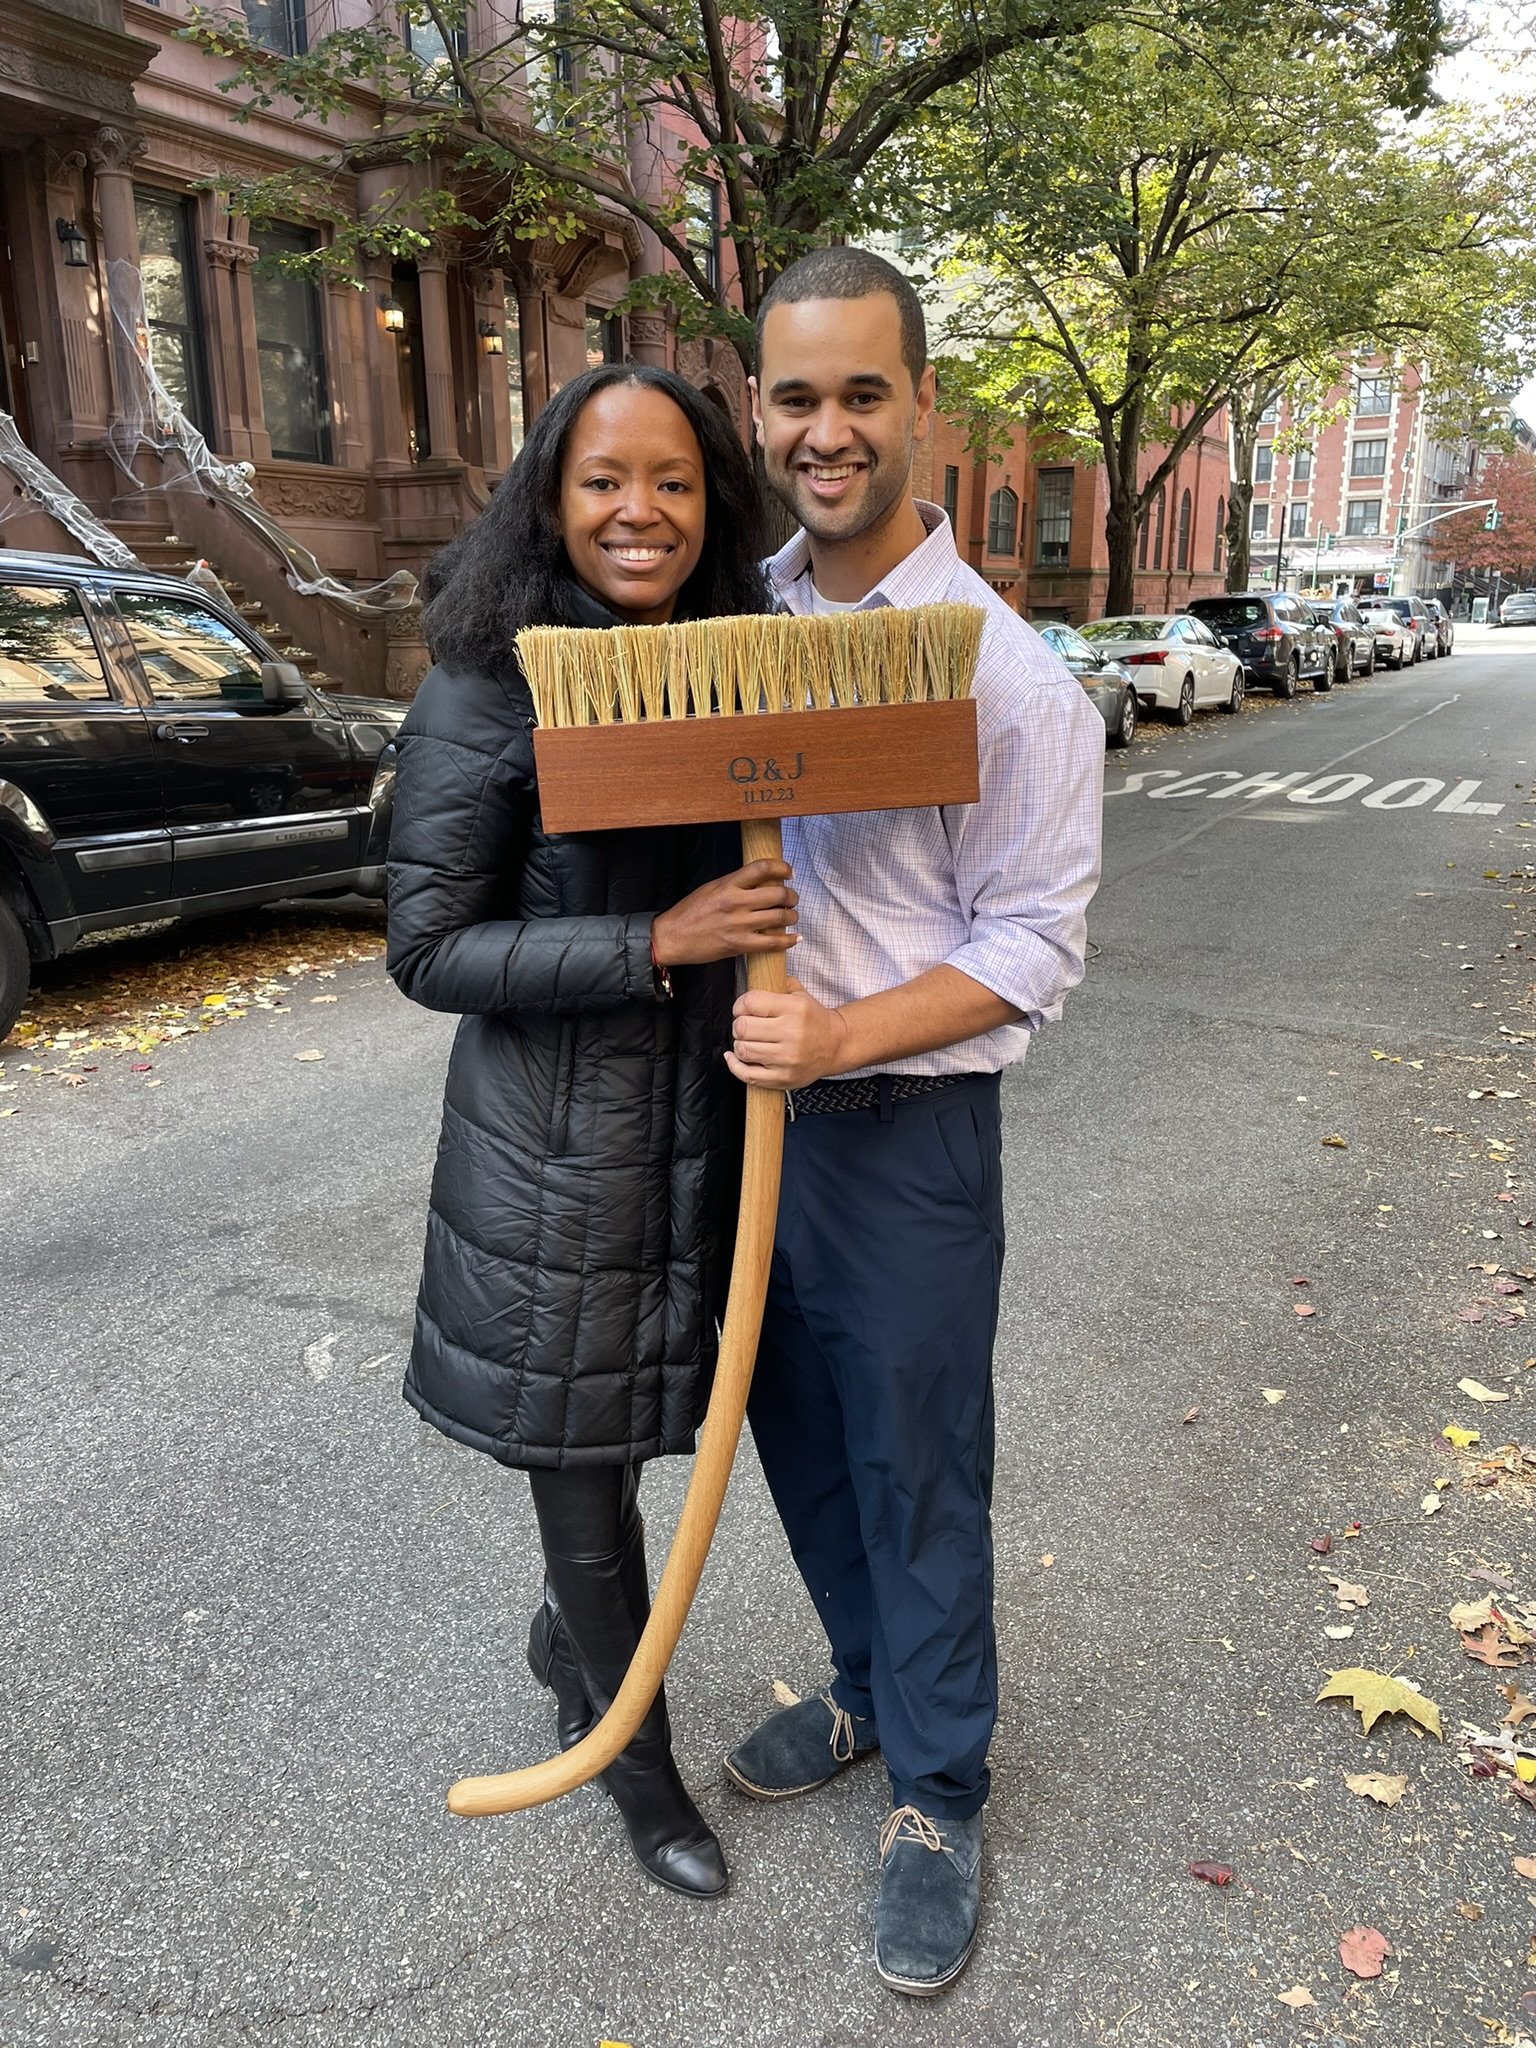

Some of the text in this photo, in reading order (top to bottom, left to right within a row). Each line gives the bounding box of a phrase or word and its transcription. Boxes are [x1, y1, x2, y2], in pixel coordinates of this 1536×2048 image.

[744, 787, 795, 804] 11.12.23
[1102, 770, 1505, 815] SCHOOL
[275, 827, 337, 841] LIBERTY
